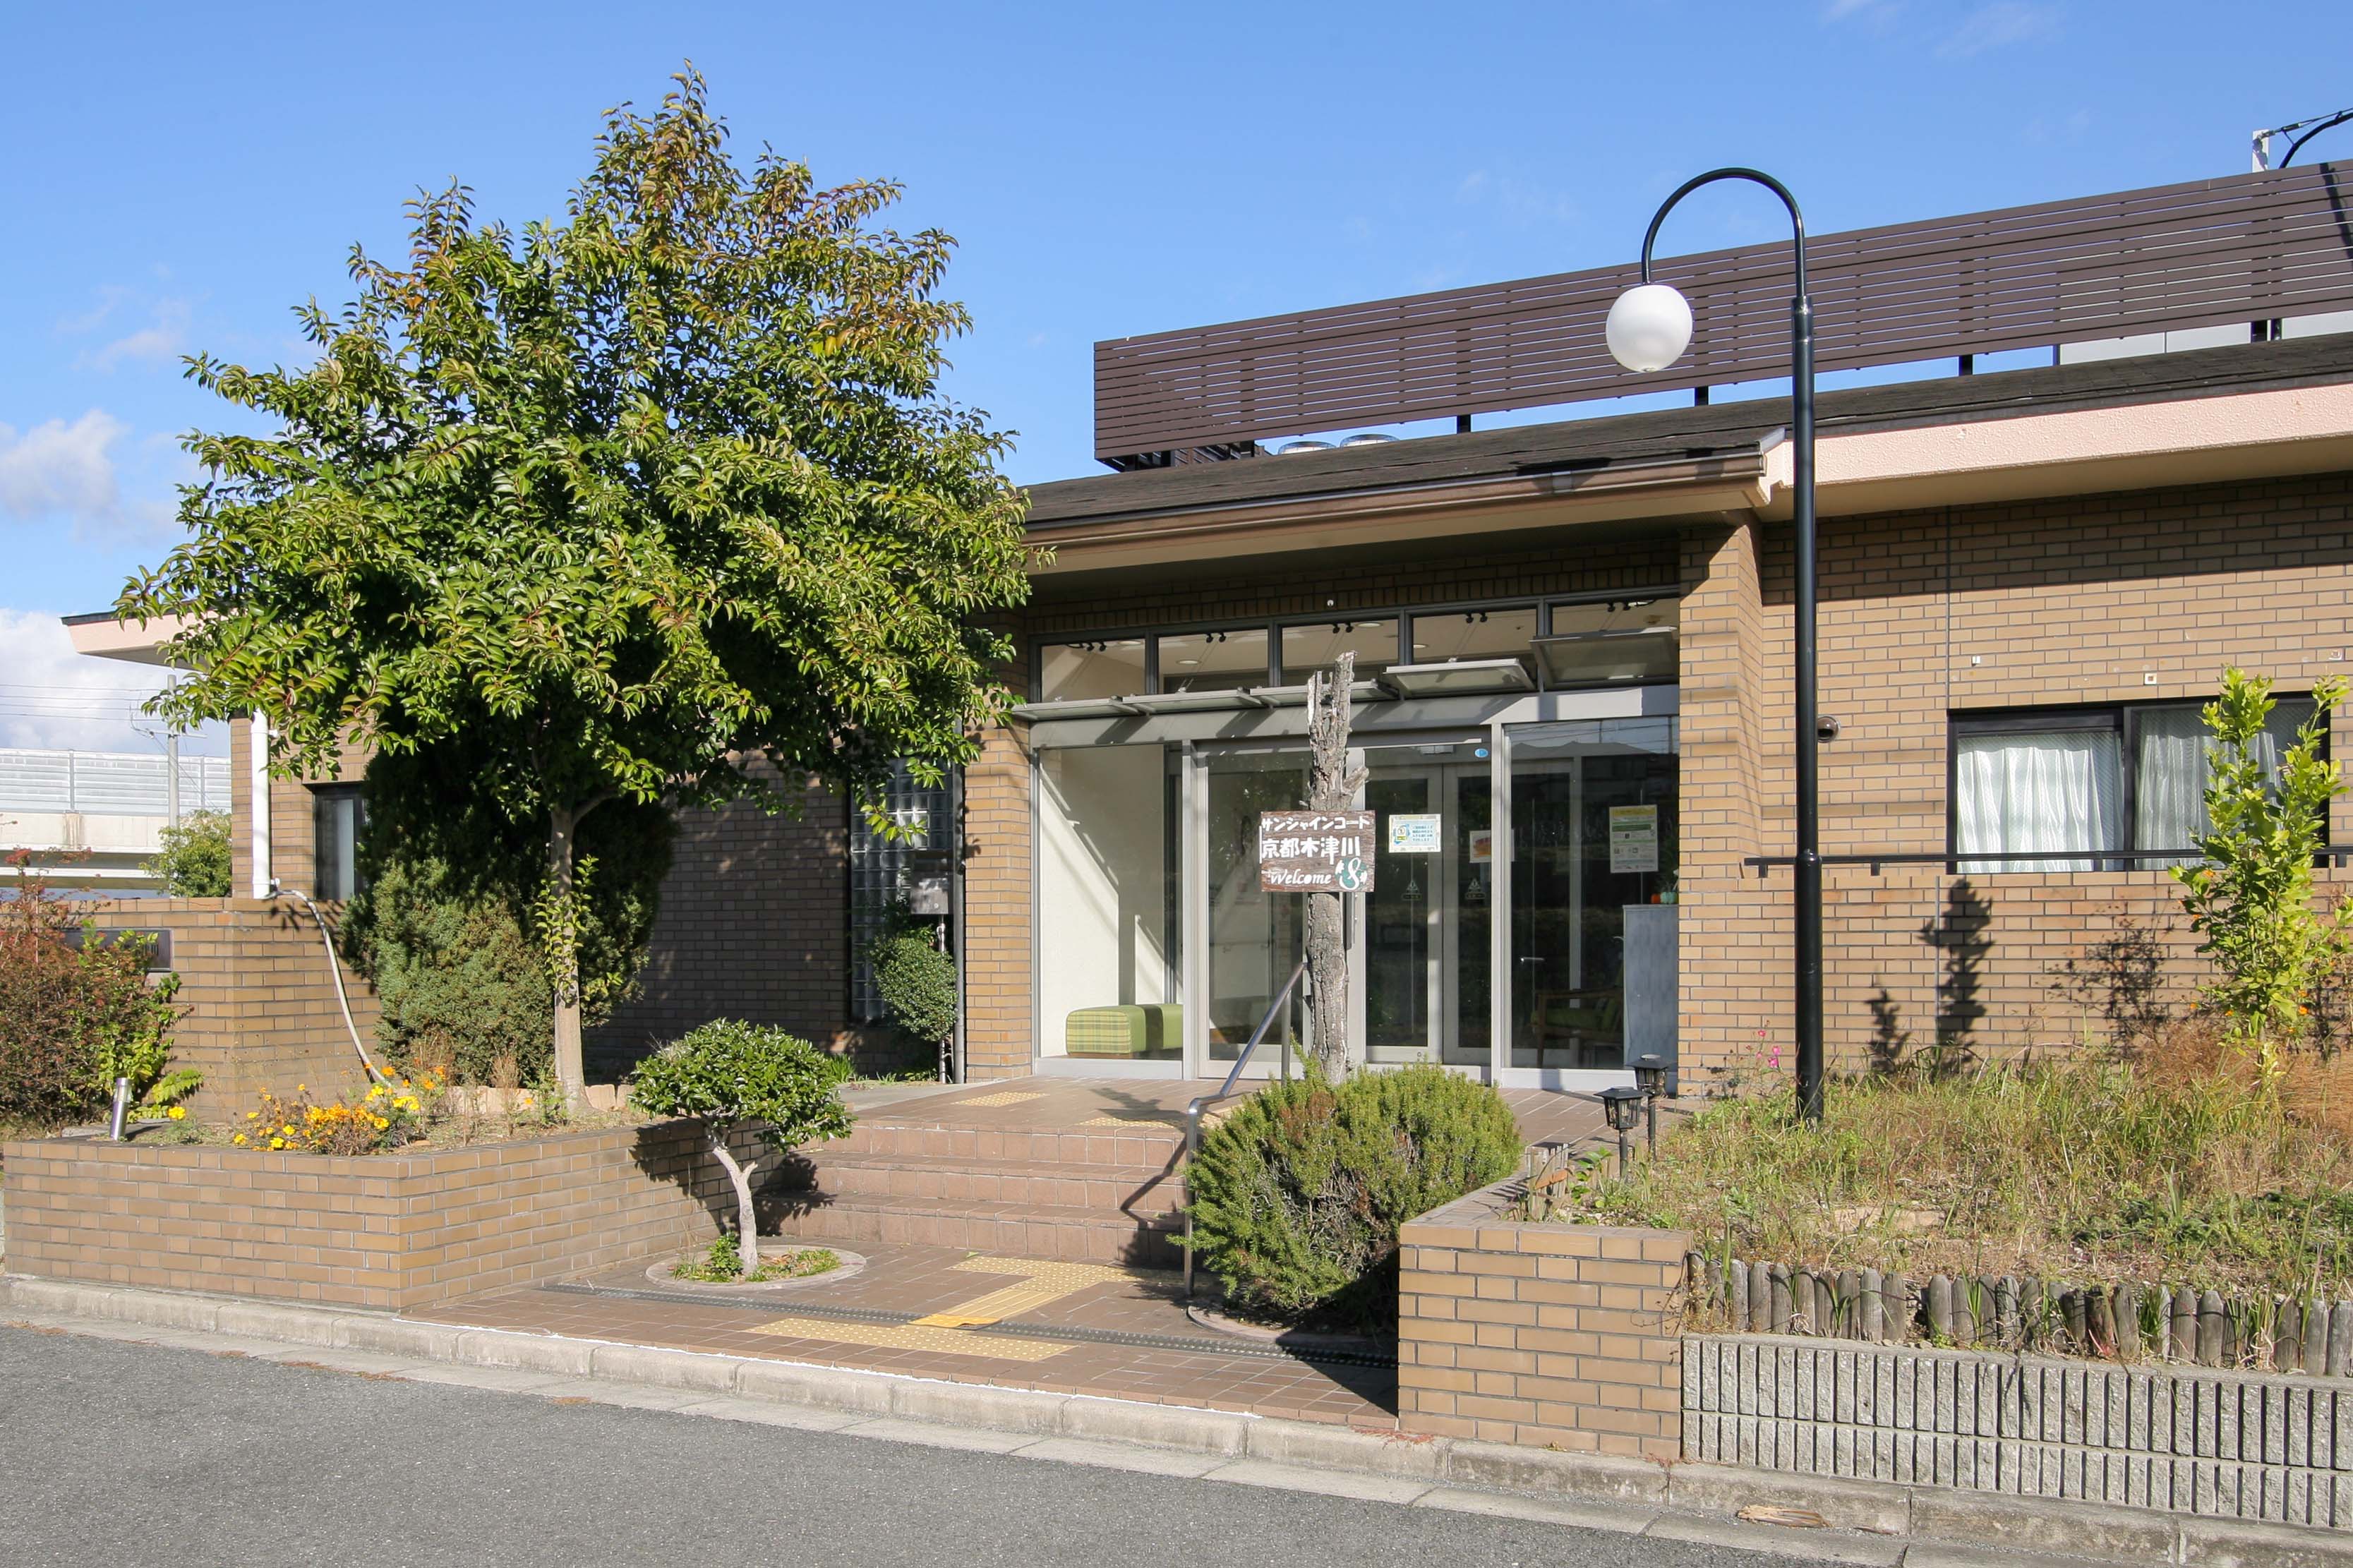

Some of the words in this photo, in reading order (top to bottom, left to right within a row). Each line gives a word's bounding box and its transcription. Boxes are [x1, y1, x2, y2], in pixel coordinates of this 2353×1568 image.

[1261, 816, 1370, 831] サンシャインコート
[1262, 836, 1361, 864] 京都木津川
[1270, 869, 1332, 884] Welcome
